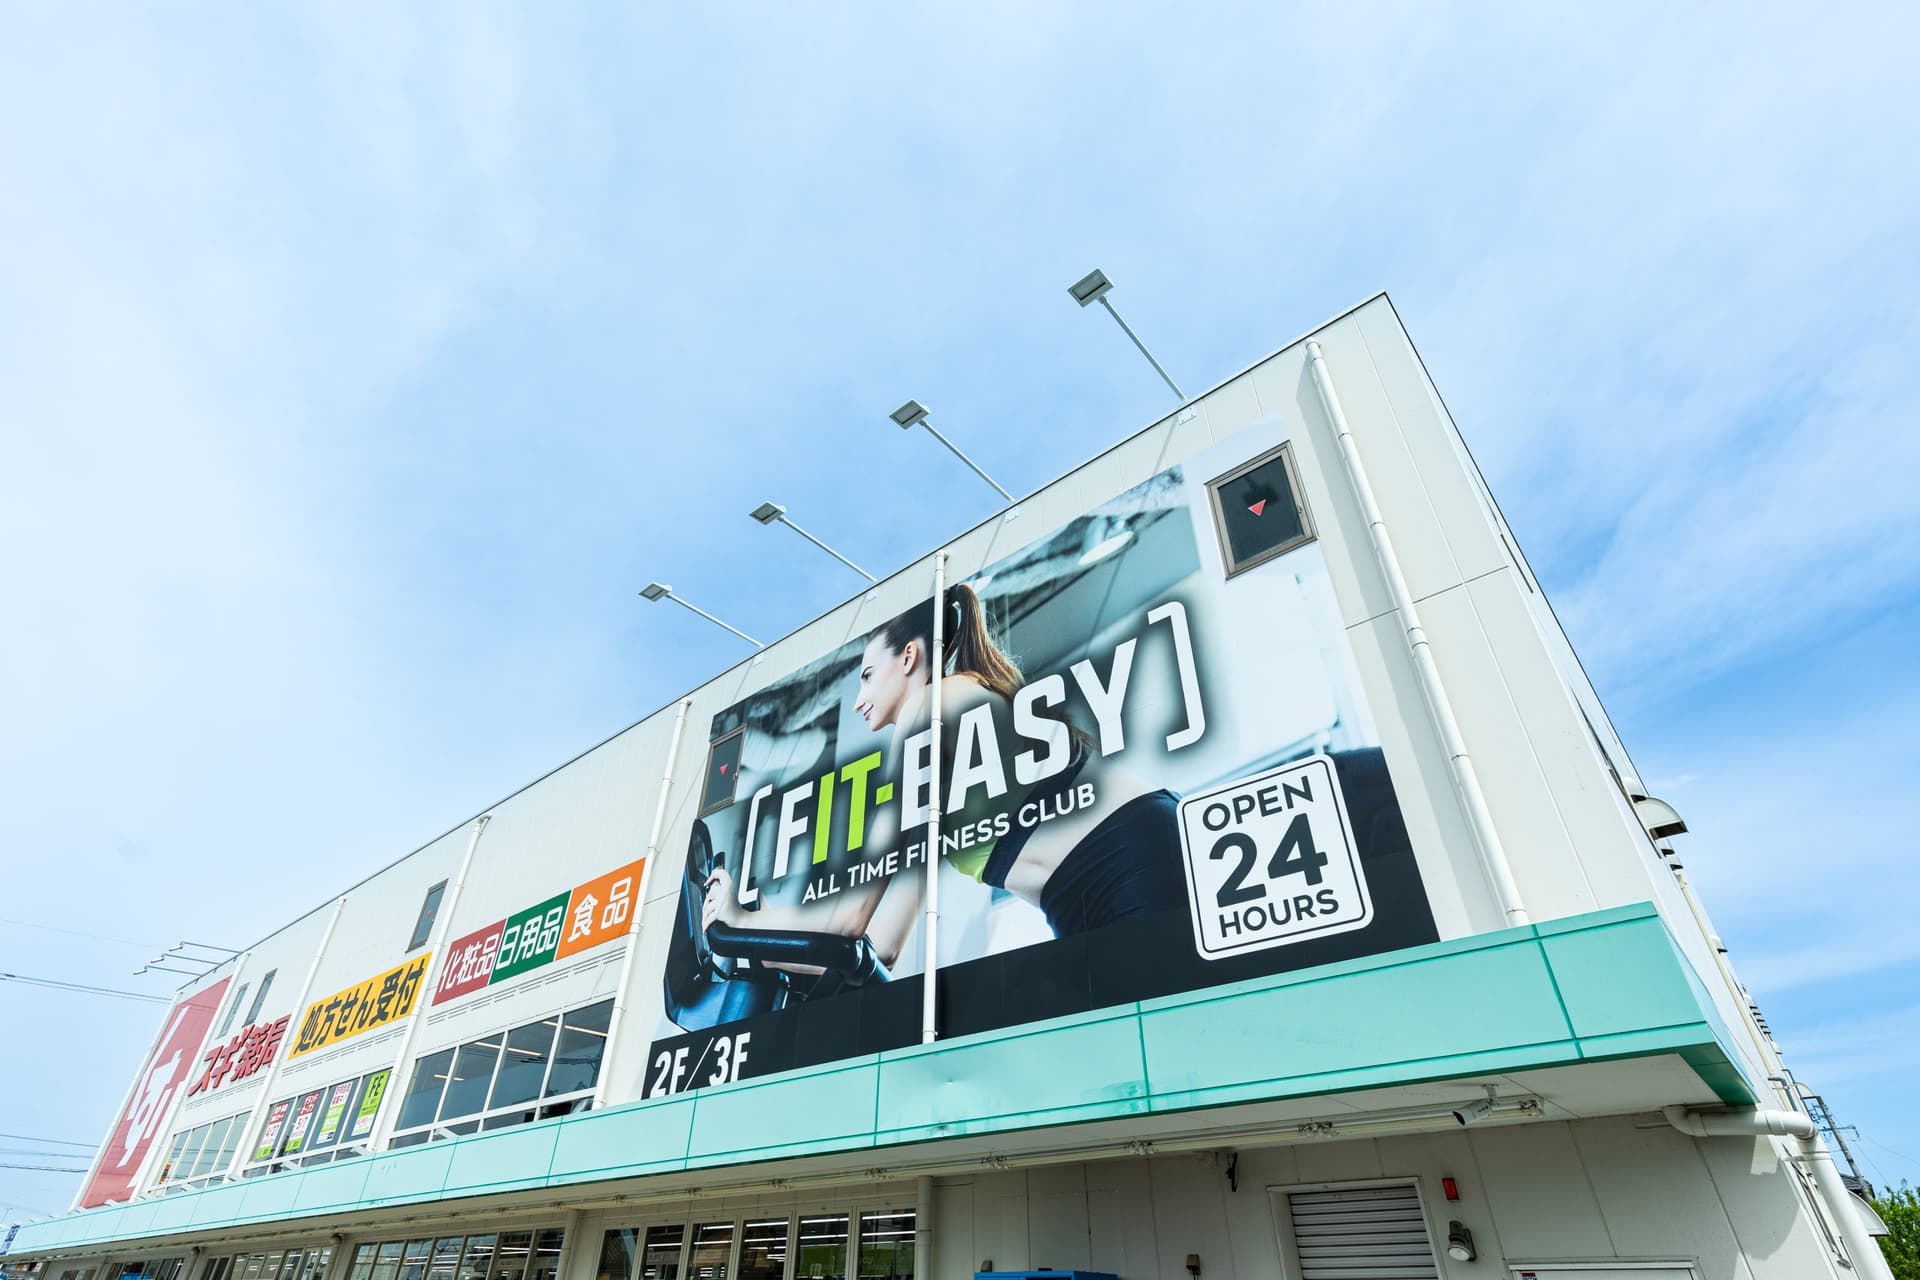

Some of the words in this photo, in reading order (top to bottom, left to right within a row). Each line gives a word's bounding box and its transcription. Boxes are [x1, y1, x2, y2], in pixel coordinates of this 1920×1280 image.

[1202, 775, 1314, 831] OPEN
[802, 877, 841, 904] ALL
[847, 851, 899, 887] TIME
[906, 812, 1010, 868] FINESS
[1018, 783, 1096, 827] CLUB
[1209, 813, 1328, 908] 24
[495, 905, 563, 971] 日用品
[568, 876, 632, 943] 食品
[1219, 889, 1339, 938] HOURS
[439, 932, 500, 993] 化粧品
[293, 958, 426, 1055] 処方せん受付
[188, 1014, 292, 1097] スギ薬局
